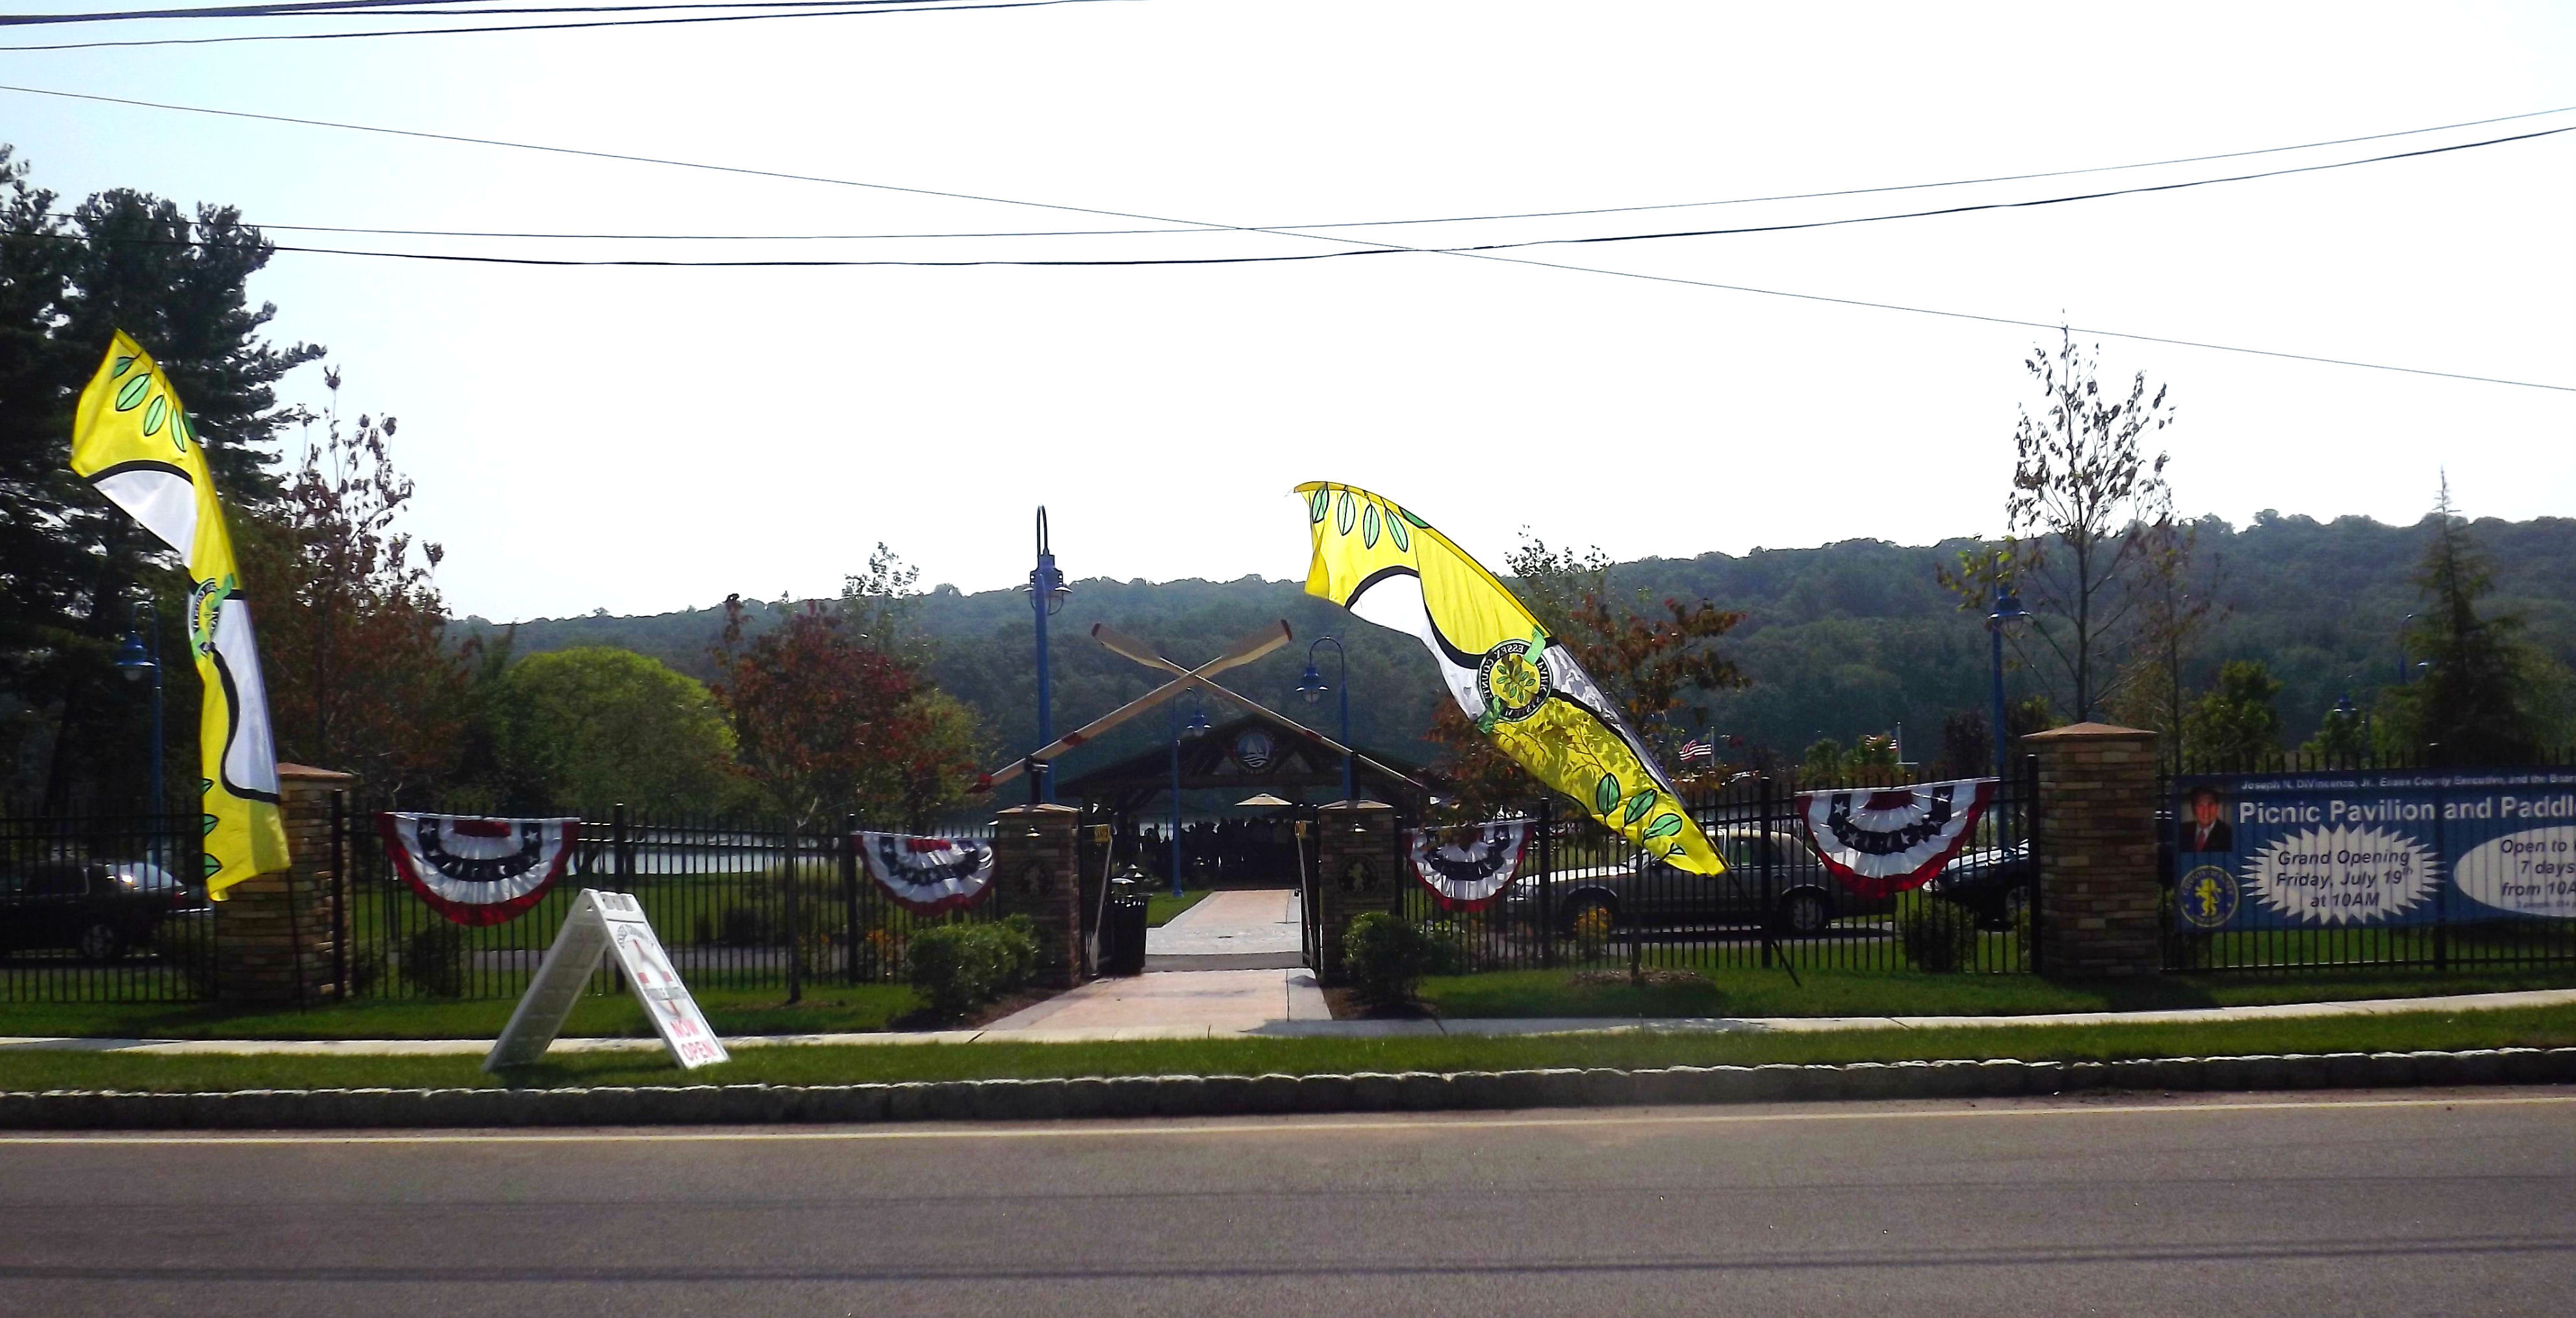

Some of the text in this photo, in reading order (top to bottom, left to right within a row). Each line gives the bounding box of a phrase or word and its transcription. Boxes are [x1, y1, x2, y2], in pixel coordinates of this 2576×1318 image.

[2241, 780, 2280, 791] Joseph
[2509, 774, 2528, 783] and
[2239, 794, 2576, 824] Picnic Pavilion and Paddl
[2501, 839, 2567, 857] Open to
[2278, 849, 2410, 867] Grand Opening
[2521, 860, 2575, 878] 7 days
[2276, 872, 2334, 889] Friday,
[2340, 872, 2377, 888] July
[2502, 881, 2540, 896] from
[2310, 893, 2380, 907] at 10AM
[669, 1019, 700, 1038] NOW
[682, 1040, 717, 1061] OPEN
